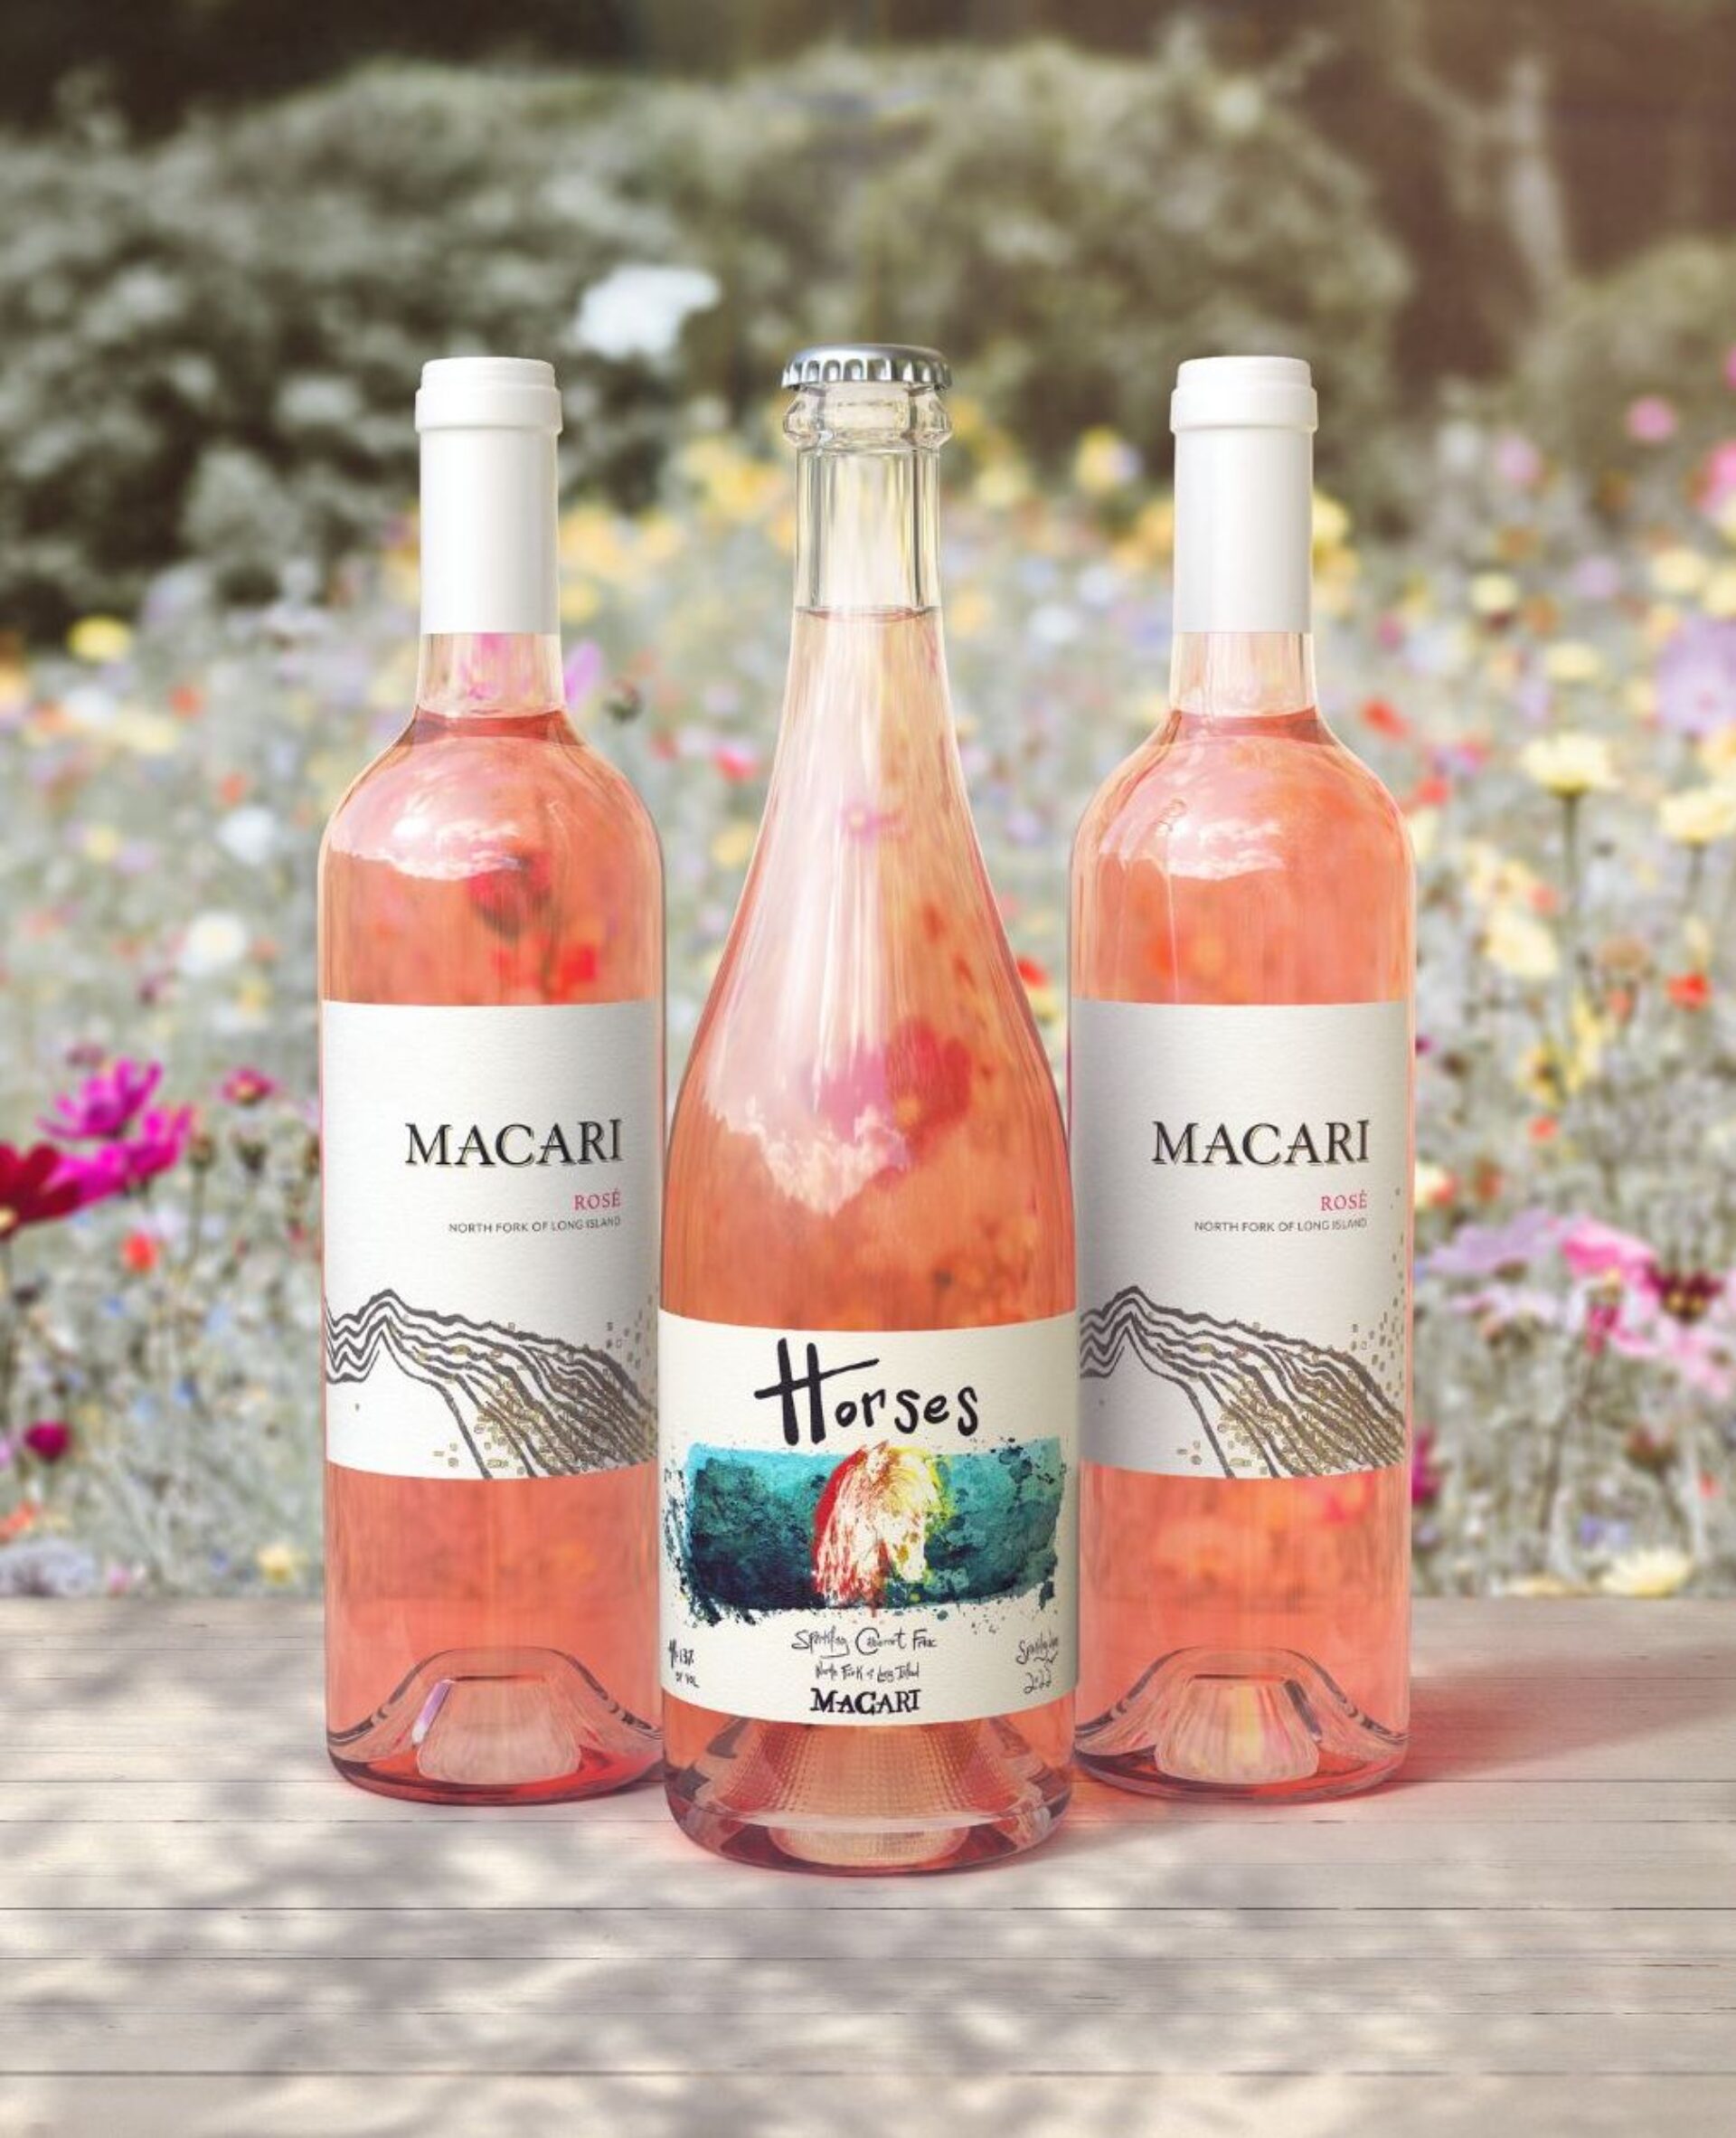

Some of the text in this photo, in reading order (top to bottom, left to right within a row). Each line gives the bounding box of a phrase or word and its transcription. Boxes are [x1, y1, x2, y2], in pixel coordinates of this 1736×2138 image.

[404, 1119, 624, 1167] MACARI
[1151, 1119, 1370, 1166] MACARI
[573, 1187, 622, 1211] ROSÉ
[1320, 1188, 1368, 1212] ROSÉ
[448, 1216, 621, 1235] NORTH FORK OF LONG ISLAND
[1194, 1216, 1368, 1233] NORTH FORK OF LONG ISLAND
[753, 1337, 979, 1446] Horses
